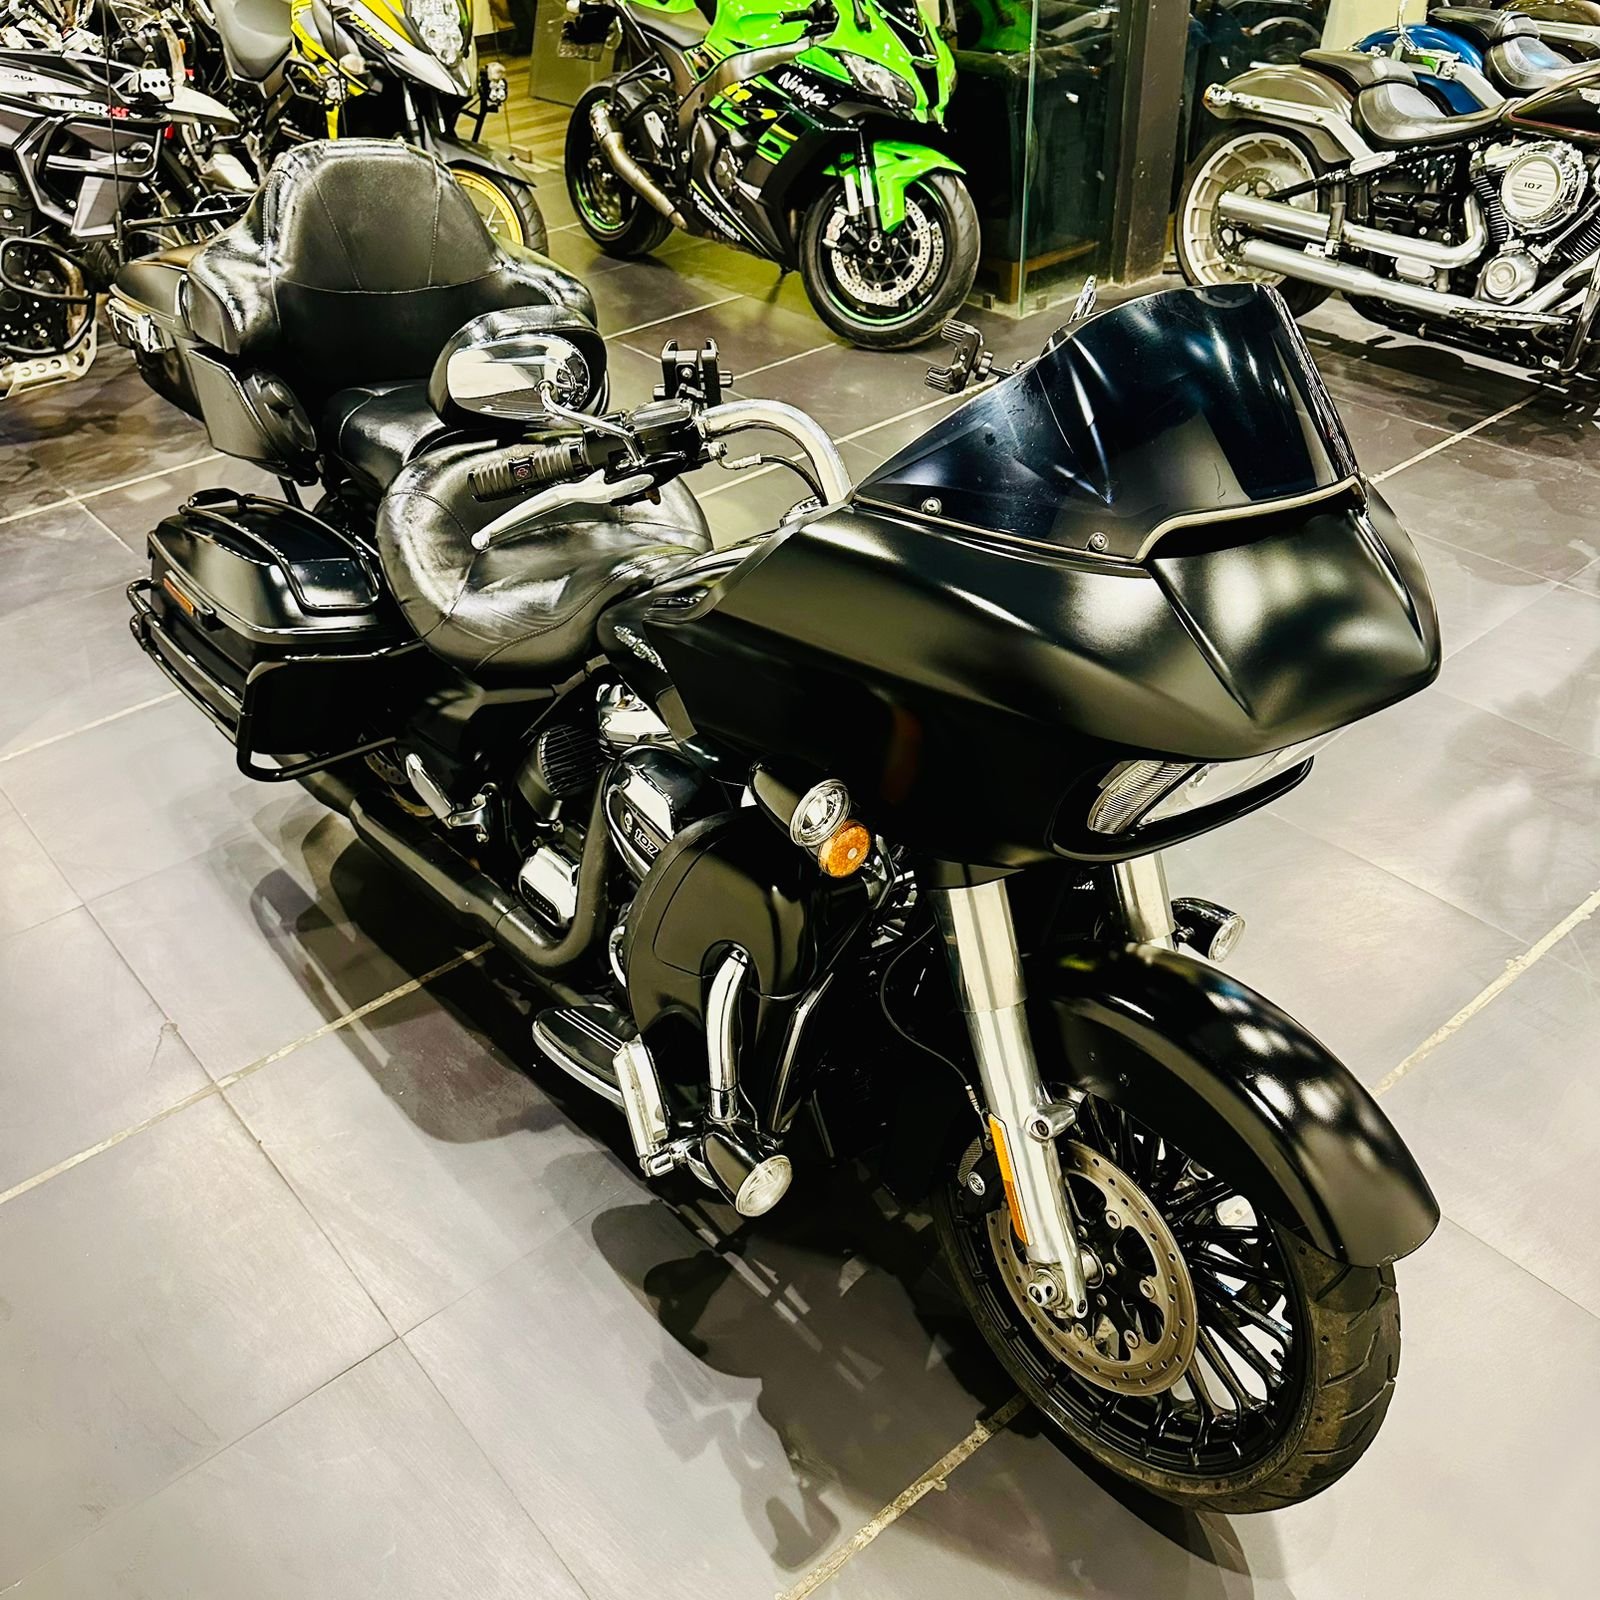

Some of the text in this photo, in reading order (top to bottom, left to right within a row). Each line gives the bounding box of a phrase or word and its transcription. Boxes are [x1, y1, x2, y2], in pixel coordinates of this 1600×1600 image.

[777, 71, 829, 106] Ninja
[51, 94, 109, 118] TIGER
[1524, 181, 1543, 190] 107
[634, 827, 660, 855] 107
